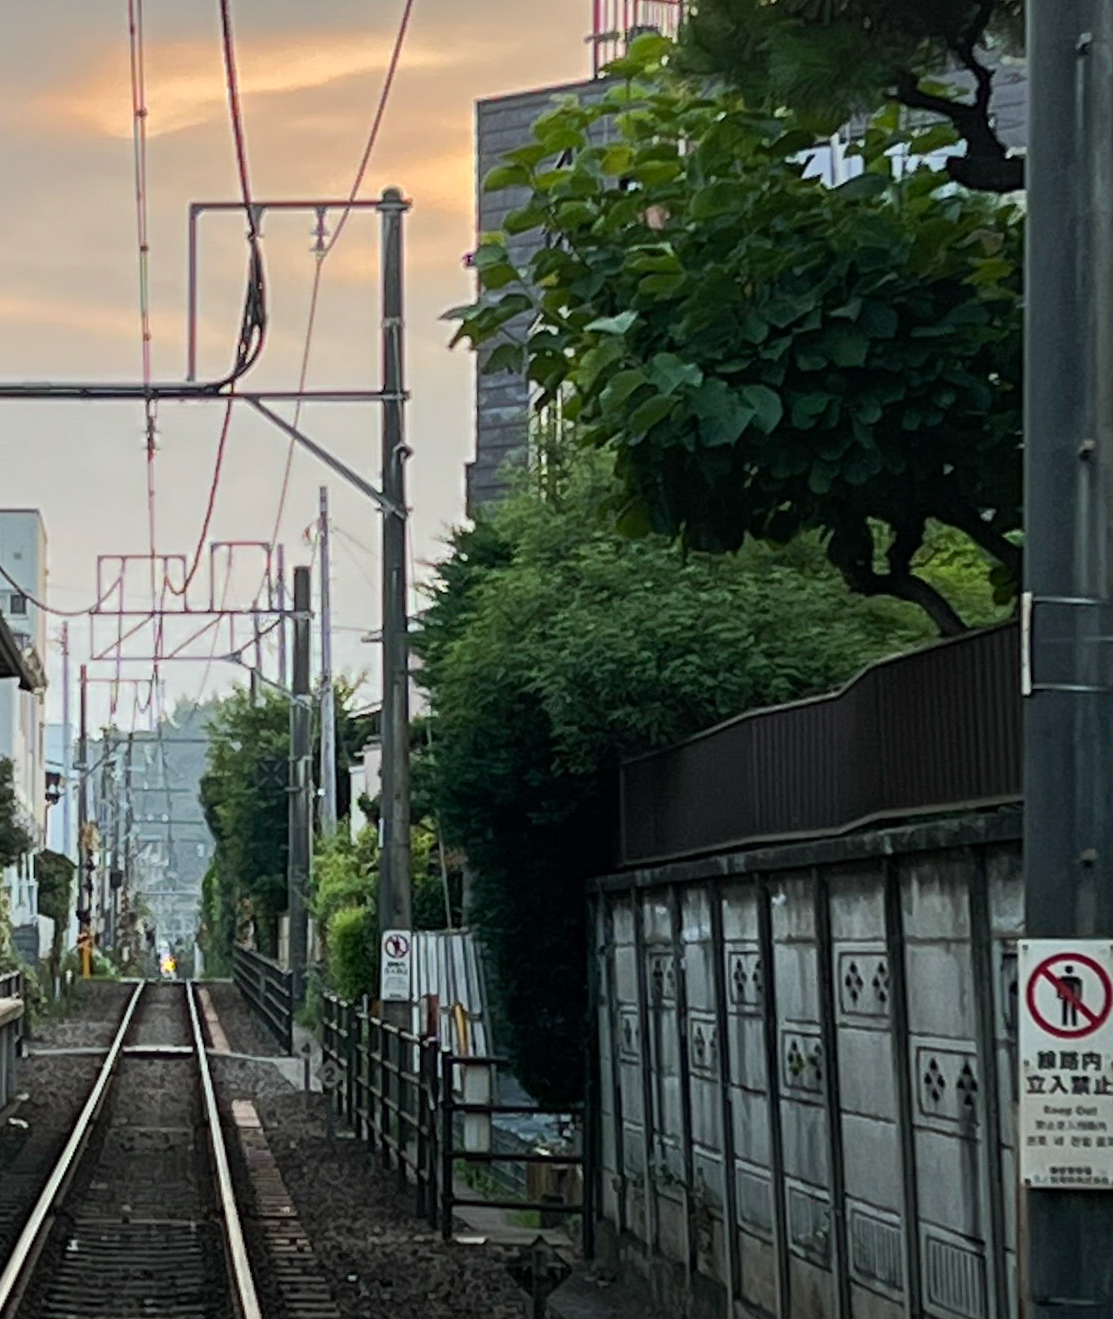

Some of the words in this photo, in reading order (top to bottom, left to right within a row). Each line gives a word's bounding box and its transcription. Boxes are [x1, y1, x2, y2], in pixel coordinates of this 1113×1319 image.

[1038, 1051, 1102, 1071] 線路内
[325, 1067, 335, 1082] 2
